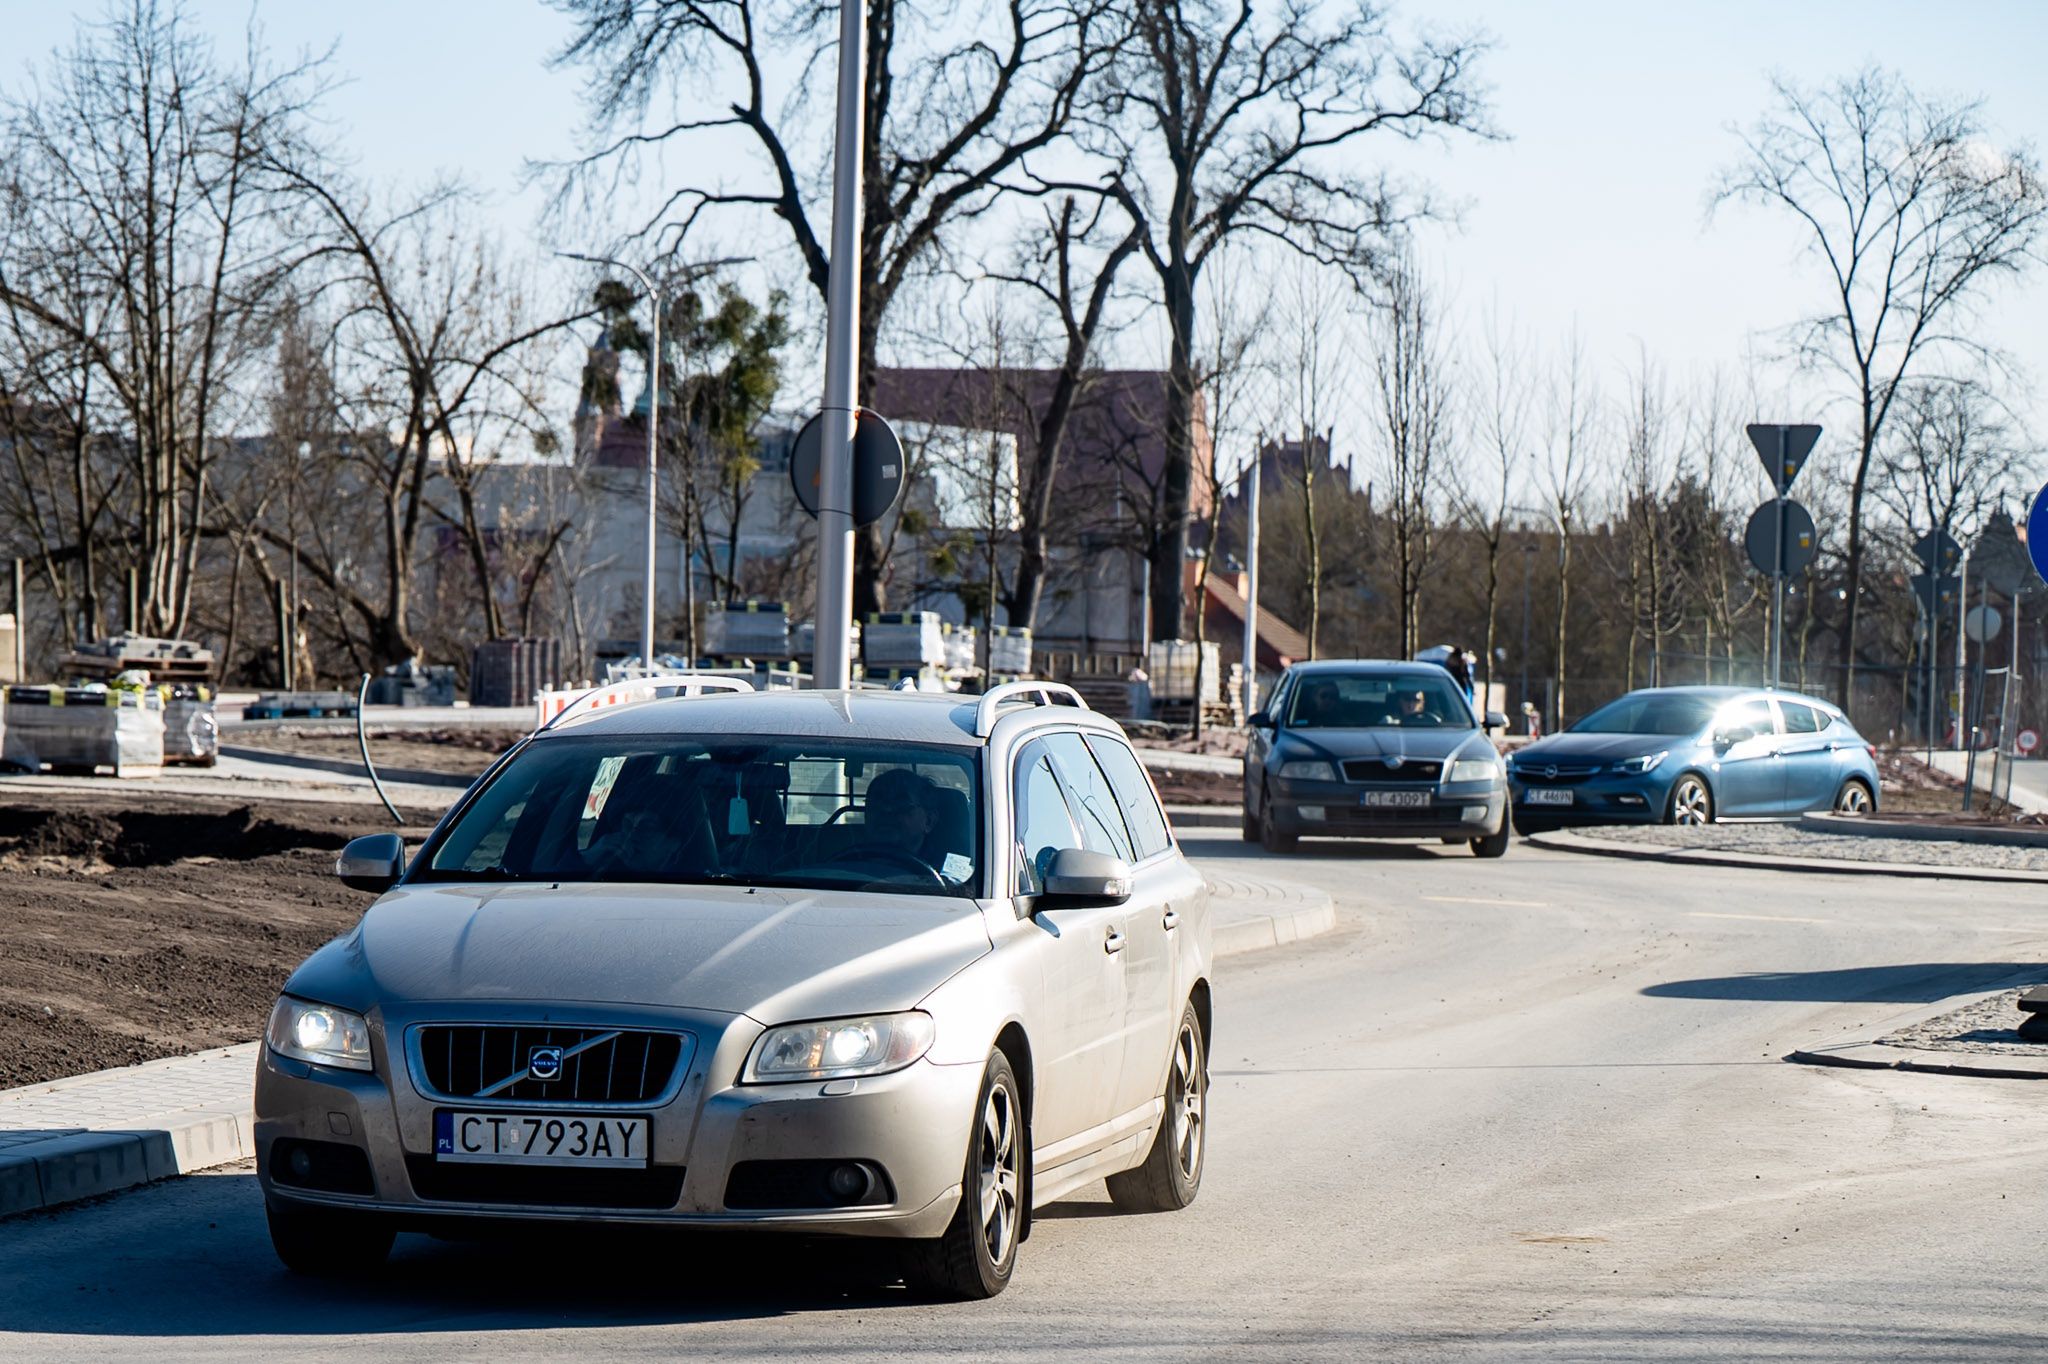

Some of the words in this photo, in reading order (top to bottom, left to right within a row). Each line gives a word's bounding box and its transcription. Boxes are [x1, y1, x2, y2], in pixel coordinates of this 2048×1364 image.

[1368, 791, 1385, 806] CT
[439, 1139, 451, 1149] PL
[461, 1117, 507, 1153] CT
[522, 1119, 637, 1157] 793AY
